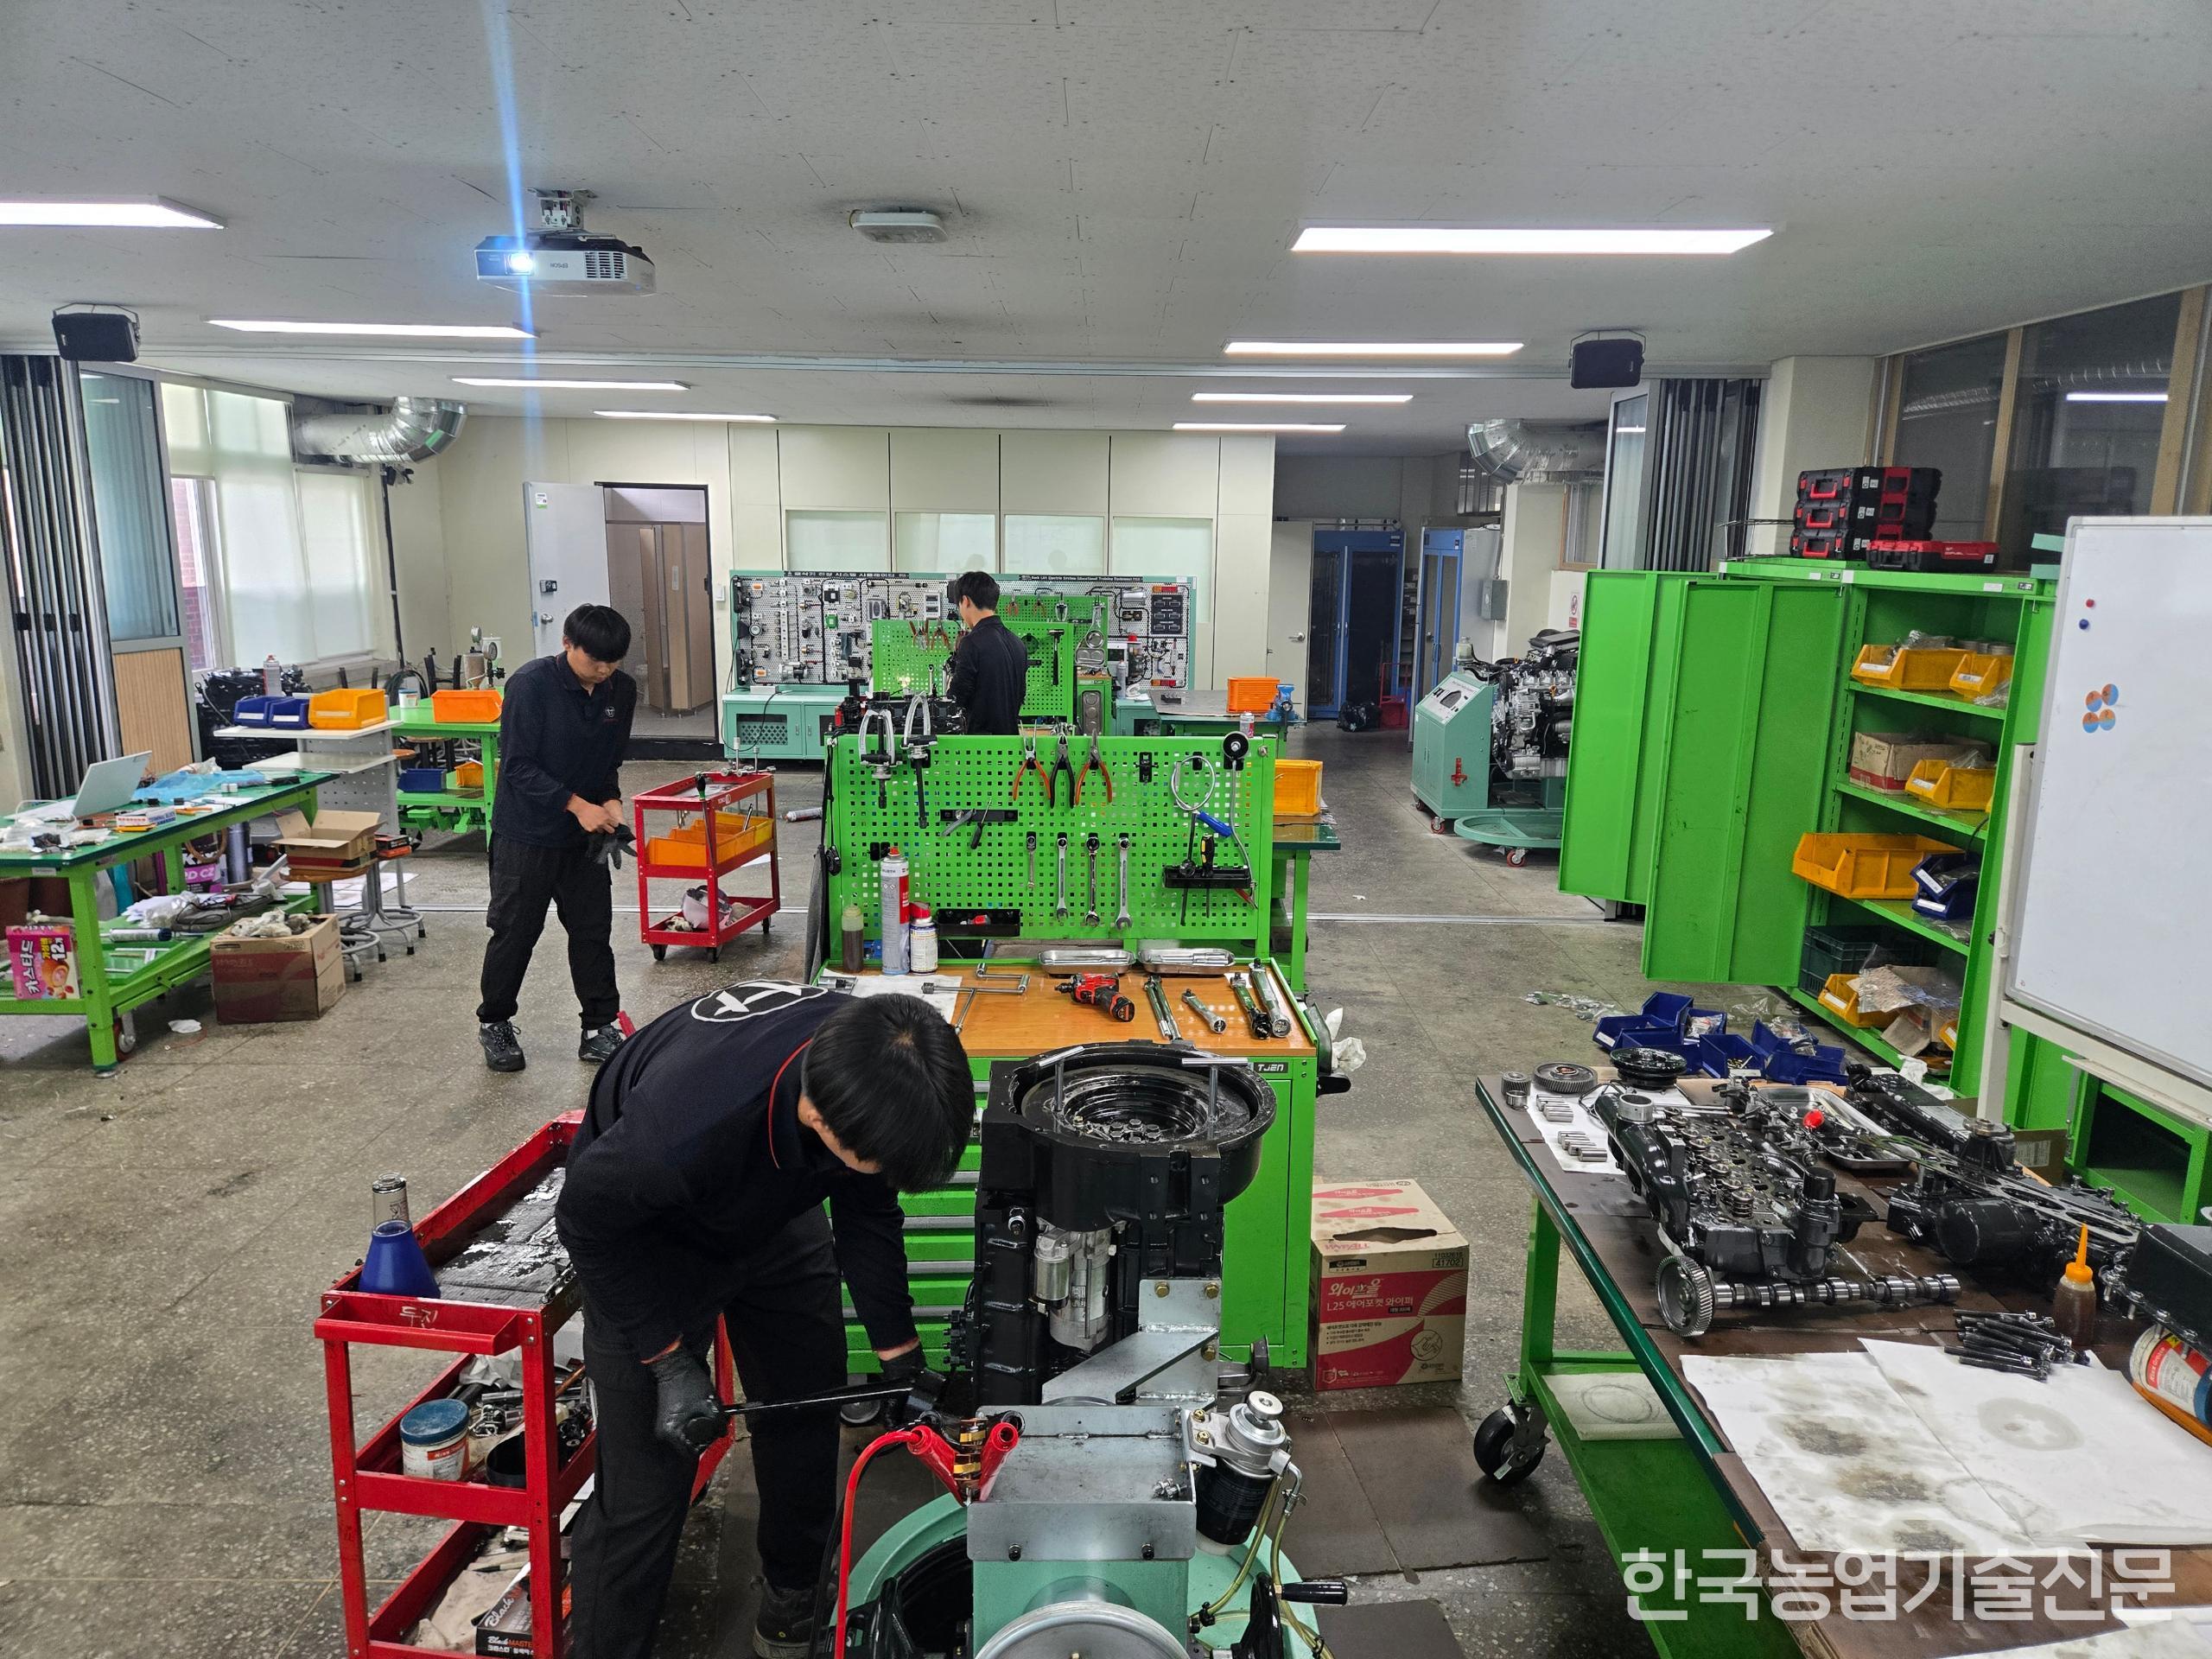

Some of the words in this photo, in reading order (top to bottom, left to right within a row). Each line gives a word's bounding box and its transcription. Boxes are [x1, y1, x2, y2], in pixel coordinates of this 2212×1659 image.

[20, 939, 41, 995] 카스타드
[1435, 1258, 1460, 1267] 41702
[1326, 1299, 1344, 1312] L25
[1385, 1296, 1414, 1306] 와이퍼
[484, 1597, 515, 1628] Black
